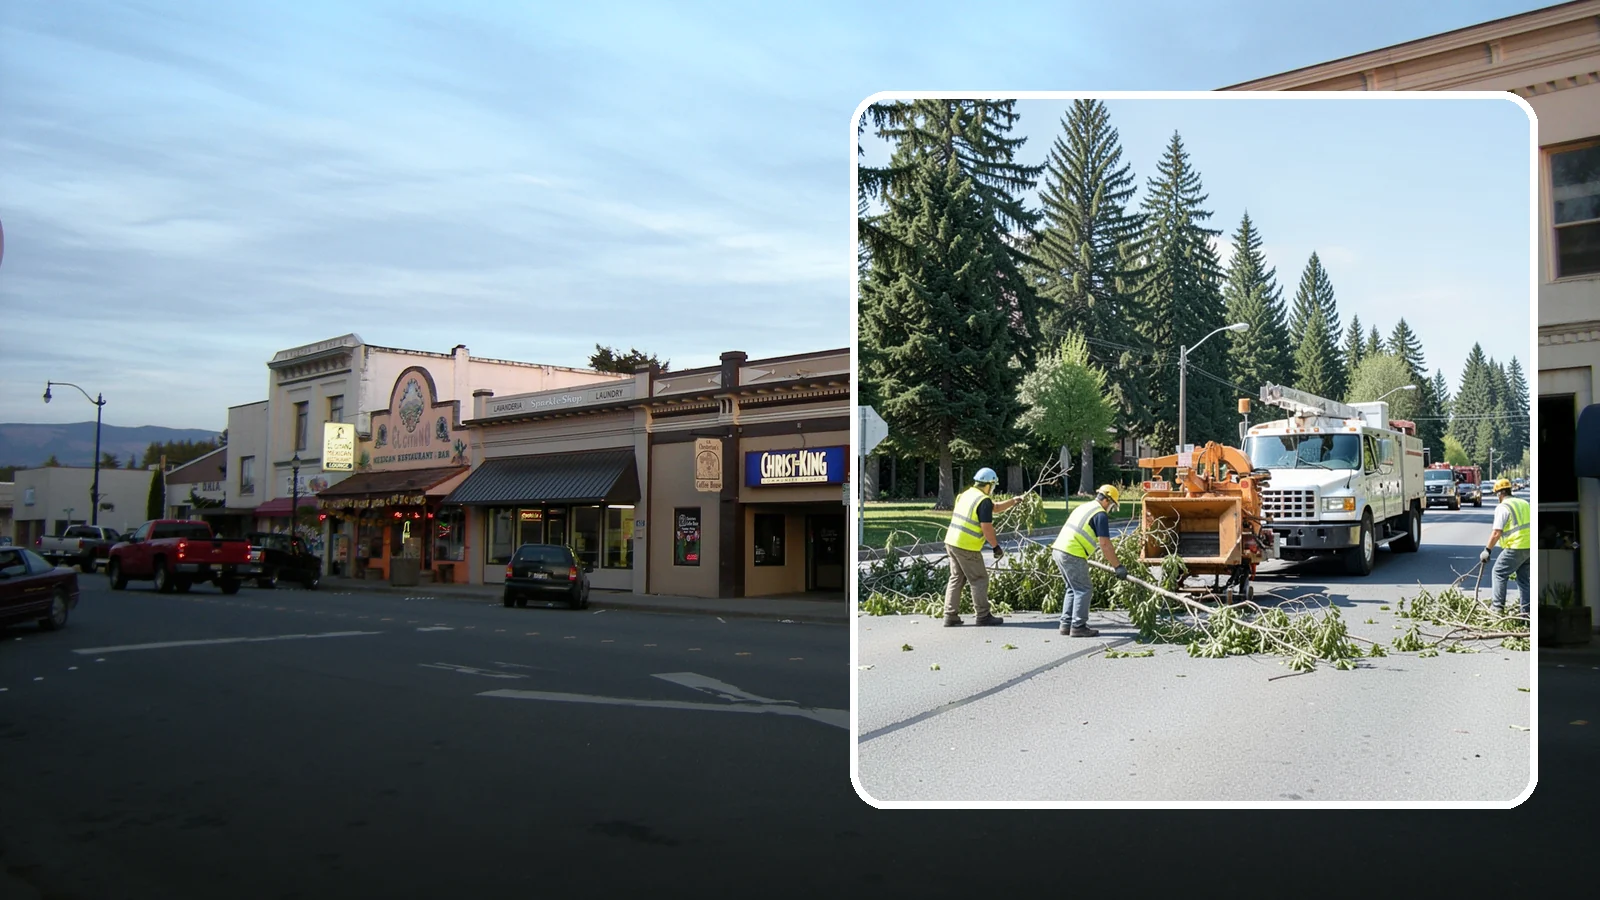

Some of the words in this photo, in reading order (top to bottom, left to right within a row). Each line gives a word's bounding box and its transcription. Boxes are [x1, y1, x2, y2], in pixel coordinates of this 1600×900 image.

[531, 397, 561, 408] Sparkle
[562, 394, 582, 403] Shop
[595, 389, 623, 400] LAUNDRY
[493, 402, 522, 412] LAVANDERIA
[373, 454, 396, 464] MEXICAN
[398, 451, 433, 462] RESTAURANT
[438, 450, 450, 459] BAR
[761, 452, 798, 478] CHRIST
[799, 450, 827, 476] KING
